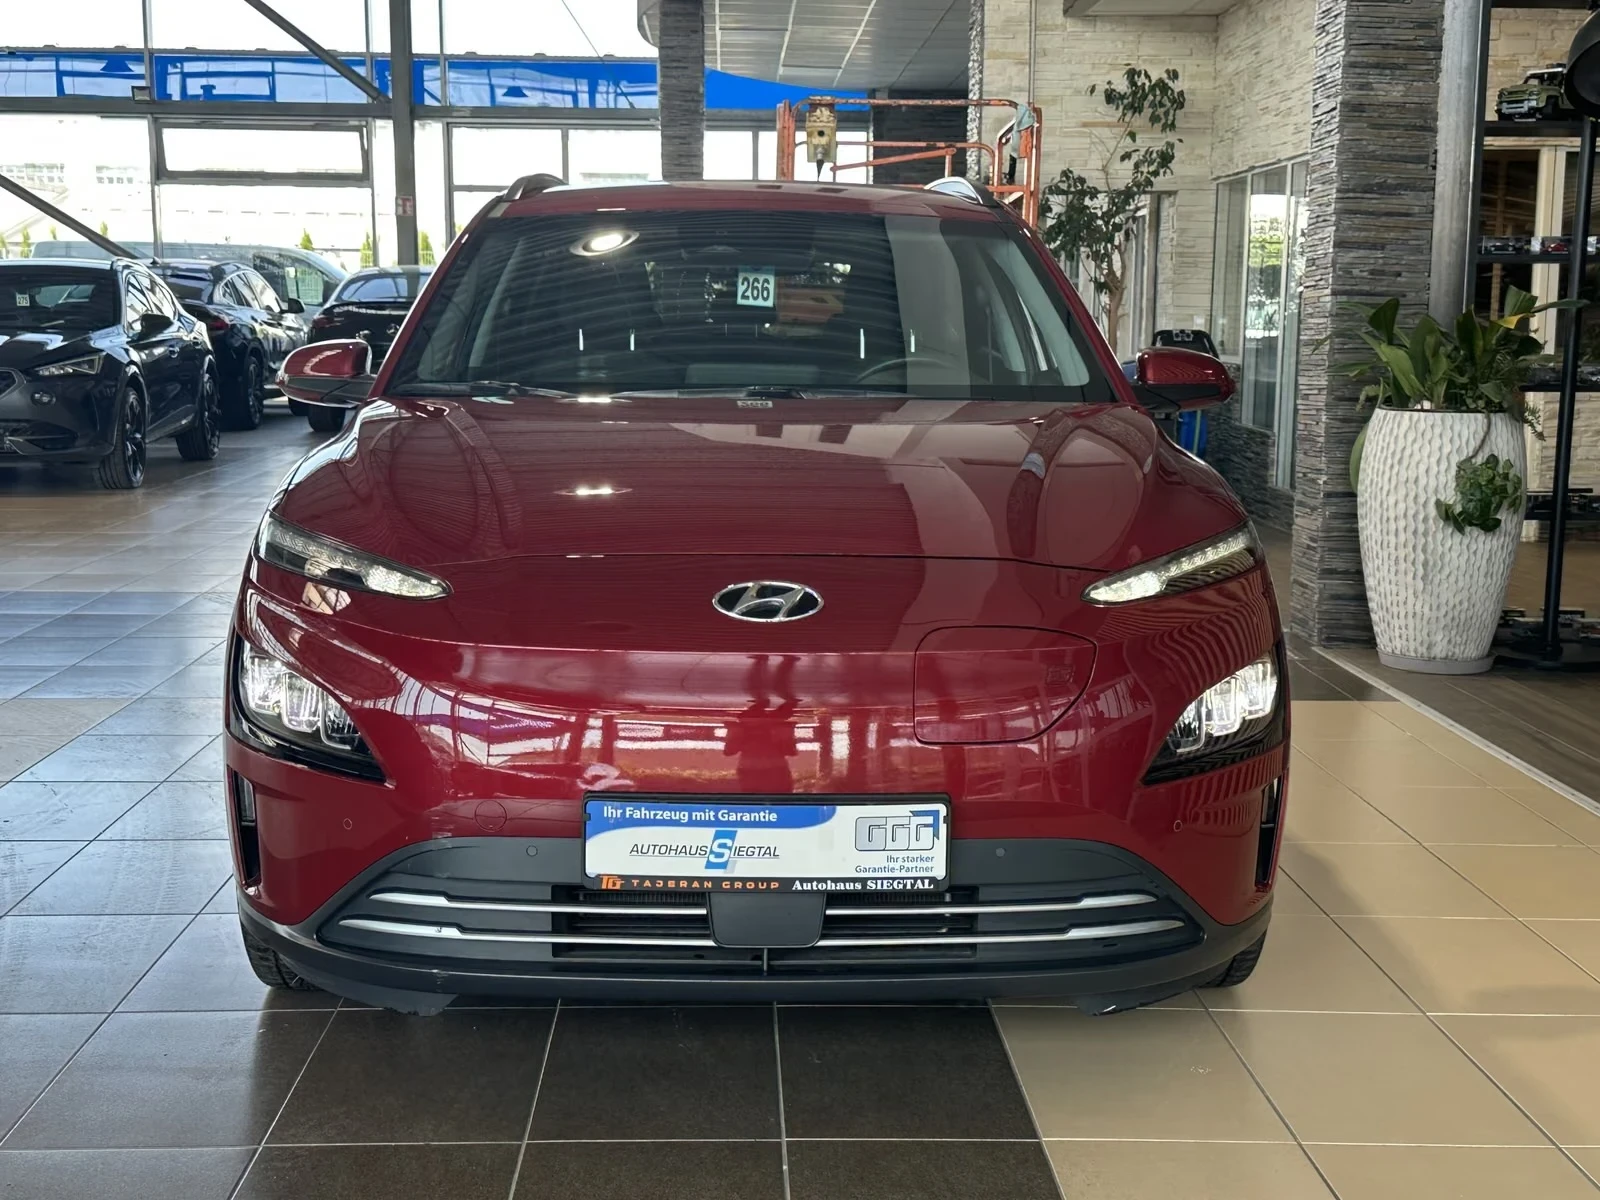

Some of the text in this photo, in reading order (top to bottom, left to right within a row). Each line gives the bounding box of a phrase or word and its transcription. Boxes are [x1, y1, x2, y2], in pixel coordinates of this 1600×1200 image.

[740, 276, 770, 302] 266
[17, 296, 29, 305] 275
[603, 806, 778, 823] Ihr Fahrzeug mit Garantie
[629, 843, 708, 857] AUTOHAUS
[886, 854, 935, 863] Ihr starker
[855, 864, 934, 874] Garantie-Partner
[631, 879, 712, 889] TAJERAN
[722, 881, 780, 890] GROUP
[792, 879, 934, 891] Autohaus SIEGTAL
